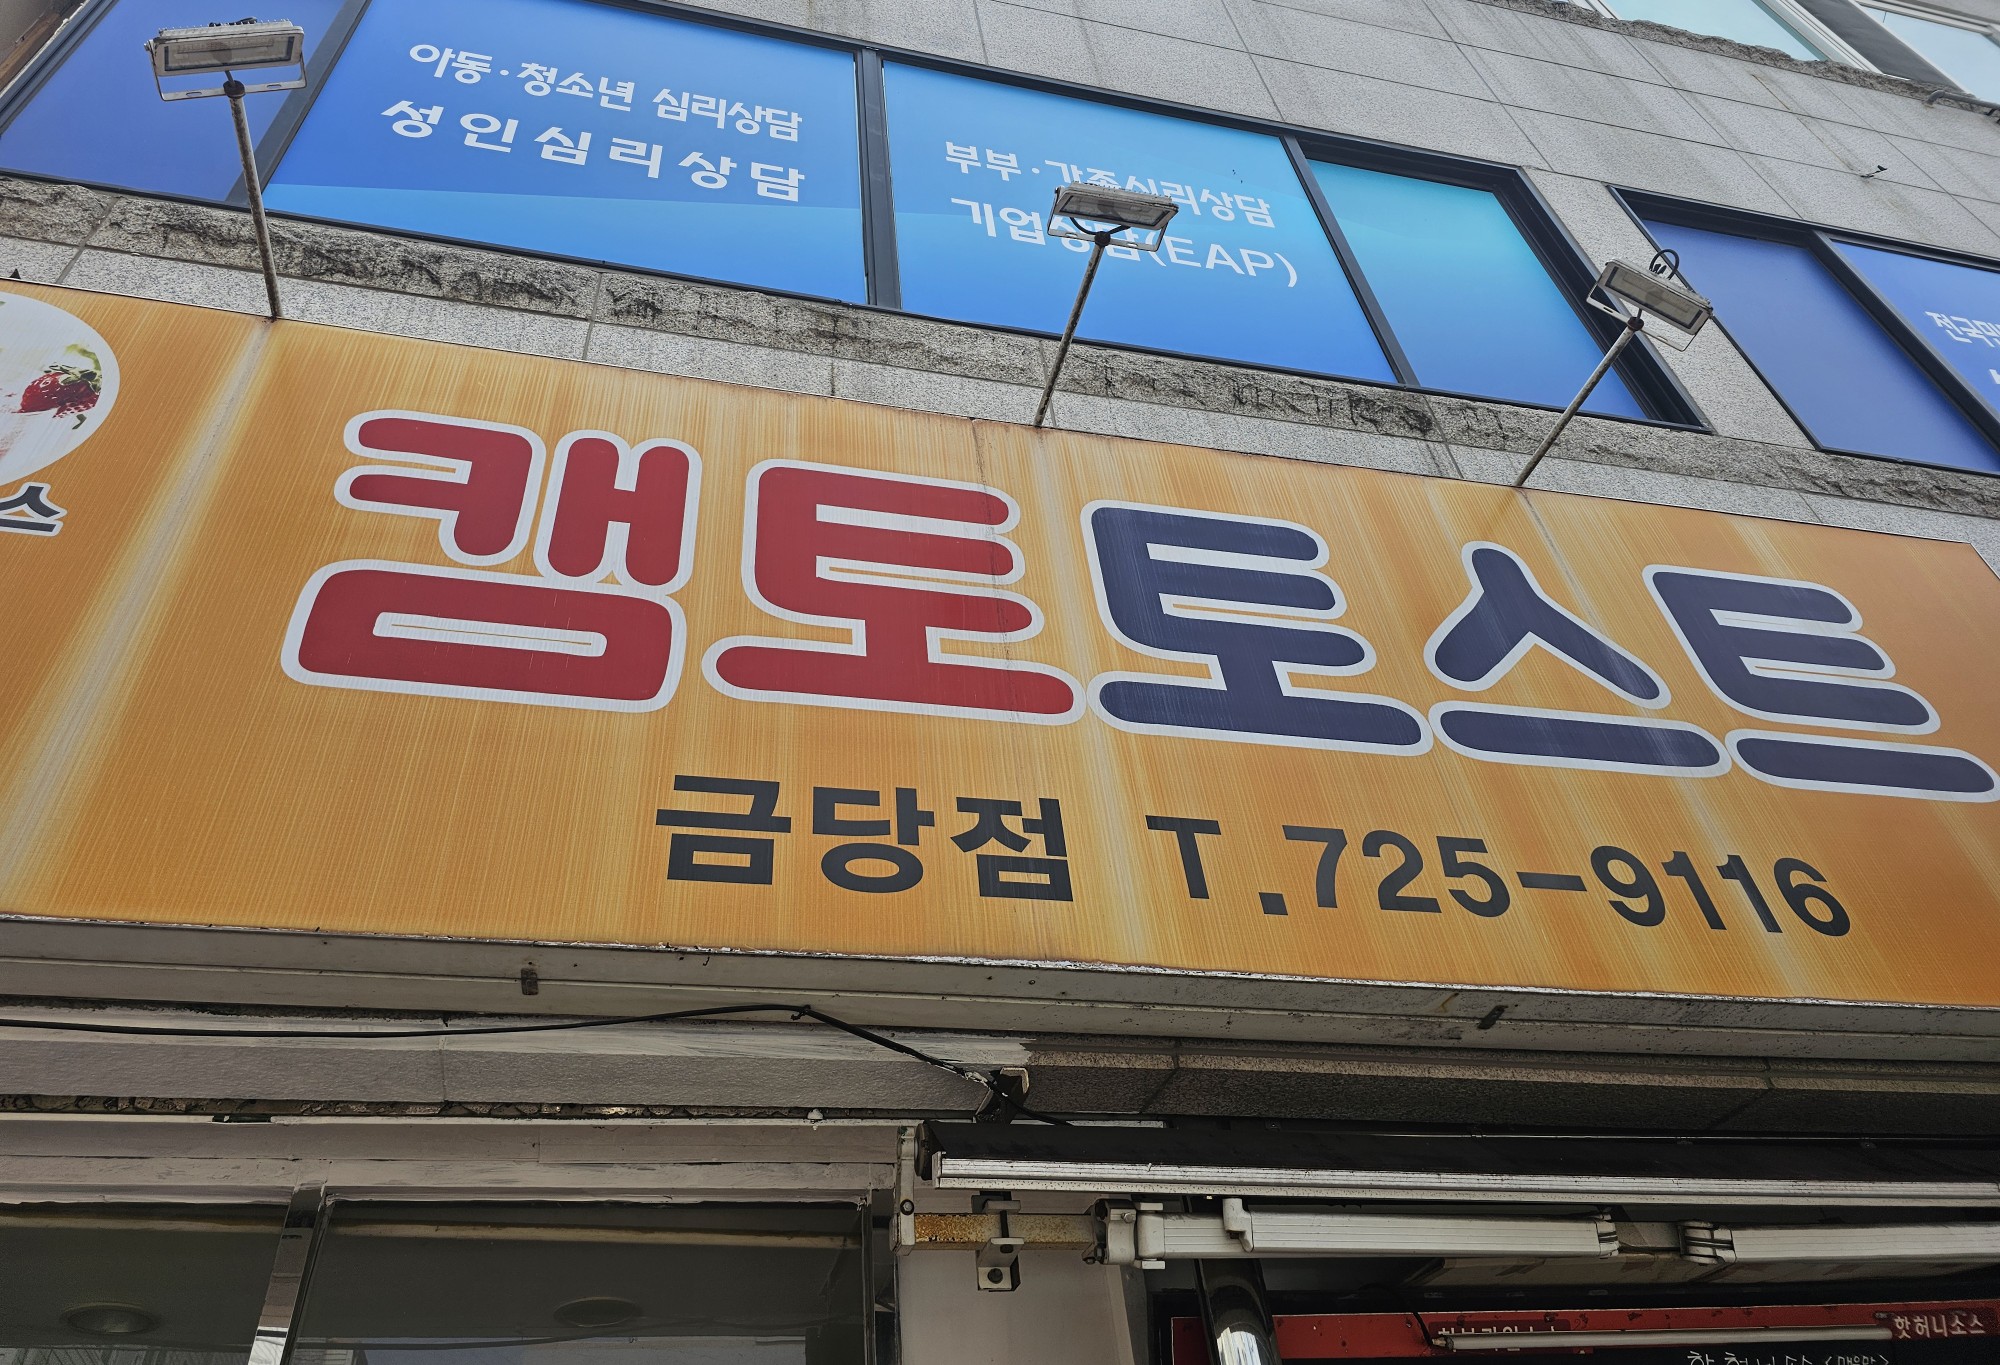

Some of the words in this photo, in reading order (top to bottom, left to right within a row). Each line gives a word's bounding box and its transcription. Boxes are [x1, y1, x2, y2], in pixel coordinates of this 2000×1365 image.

[651, 88, 803, 142] 심리상담
[656, 774, 1074, 902] 금당점
[1893, 1314, 1986, 1339] 핫허니소스
